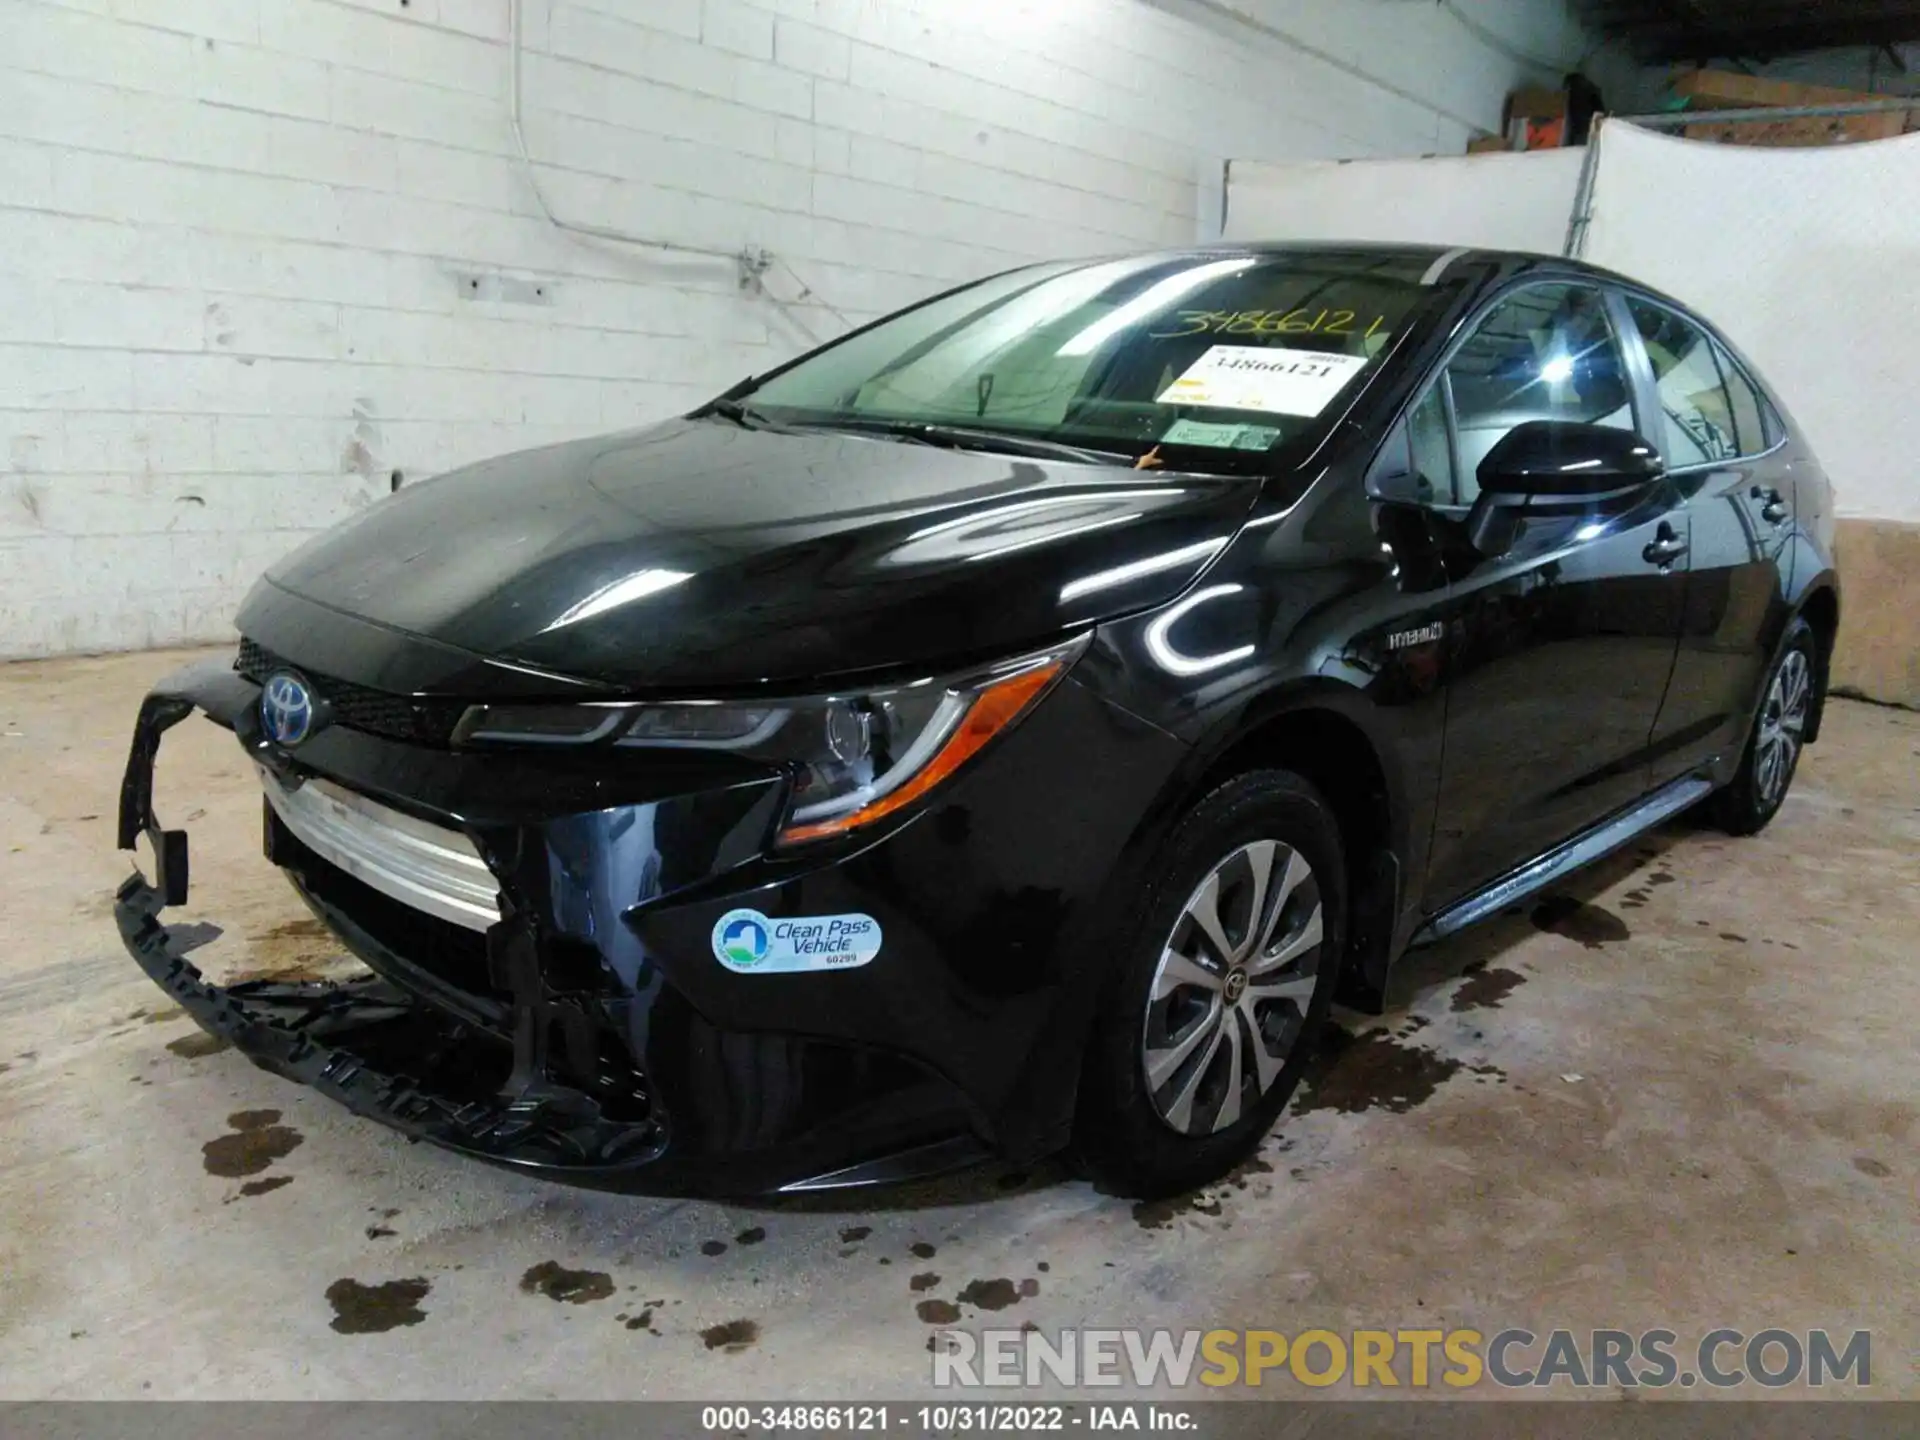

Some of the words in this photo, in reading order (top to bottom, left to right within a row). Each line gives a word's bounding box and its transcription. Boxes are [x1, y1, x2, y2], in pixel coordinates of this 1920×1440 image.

[775, 923, 822, 939] Clean
[828, 920, 872, 935] Pass
[794, 937, 852, 954] Vehicle
